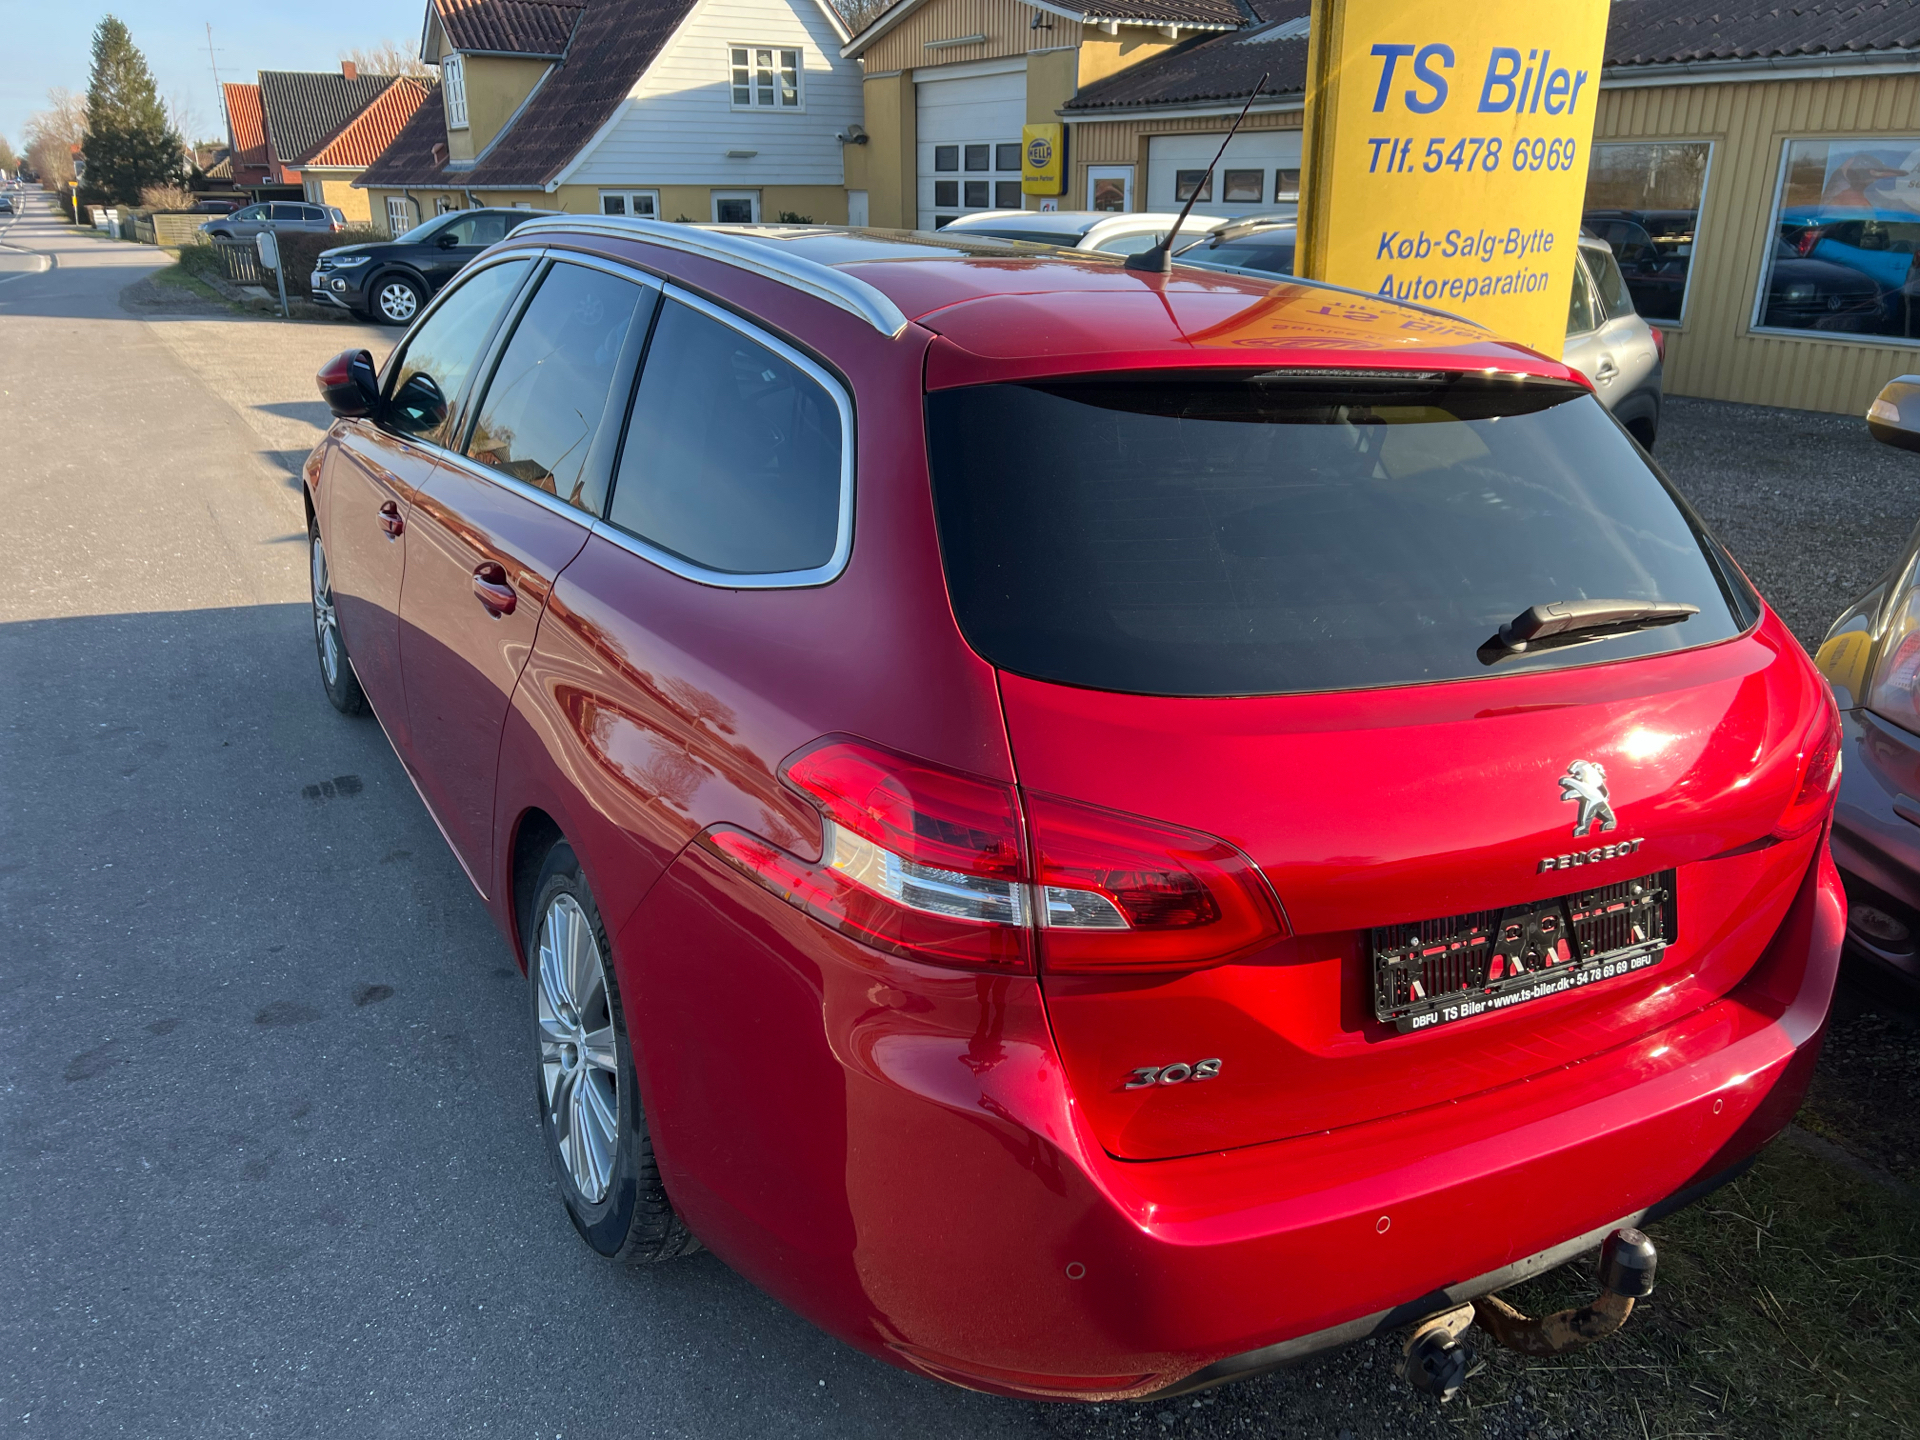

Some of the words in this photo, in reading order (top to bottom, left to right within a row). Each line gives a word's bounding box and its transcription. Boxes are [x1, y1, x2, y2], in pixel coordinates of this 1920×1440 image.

[1370, 43, 1455, 114] TS
[1477, 47, 1588, 115] Biler
[1029, 146, 1052, 159] HELLA
[1368, 138, 1414, 173] Tlf.
[1423, 138, 1503, 173] 5478
[1512, 137, 1576, 171] 6969
[1376, 228, 1554, 262] Køb-Salg-Bytte
[1378, 267, 1549, 302] Autoreparation
[1536, 837, 1645, 875] PEUGEOT
[1412, 1012, 1438, 1028] DBFU
[1443, 1006, 1458, 1021] TS
[1461, 1001, 1486, 1017] Biler
[1577, 971, 1588, 985] 54
[1590, 968, 1601, 981] 78
[1603, 964, 1614, 977] 69
[1616, 960, 1628, 974] 69
[1631, 954, 1651, 969] DBFU
[1125, 1058, 1221, 1090] 308
